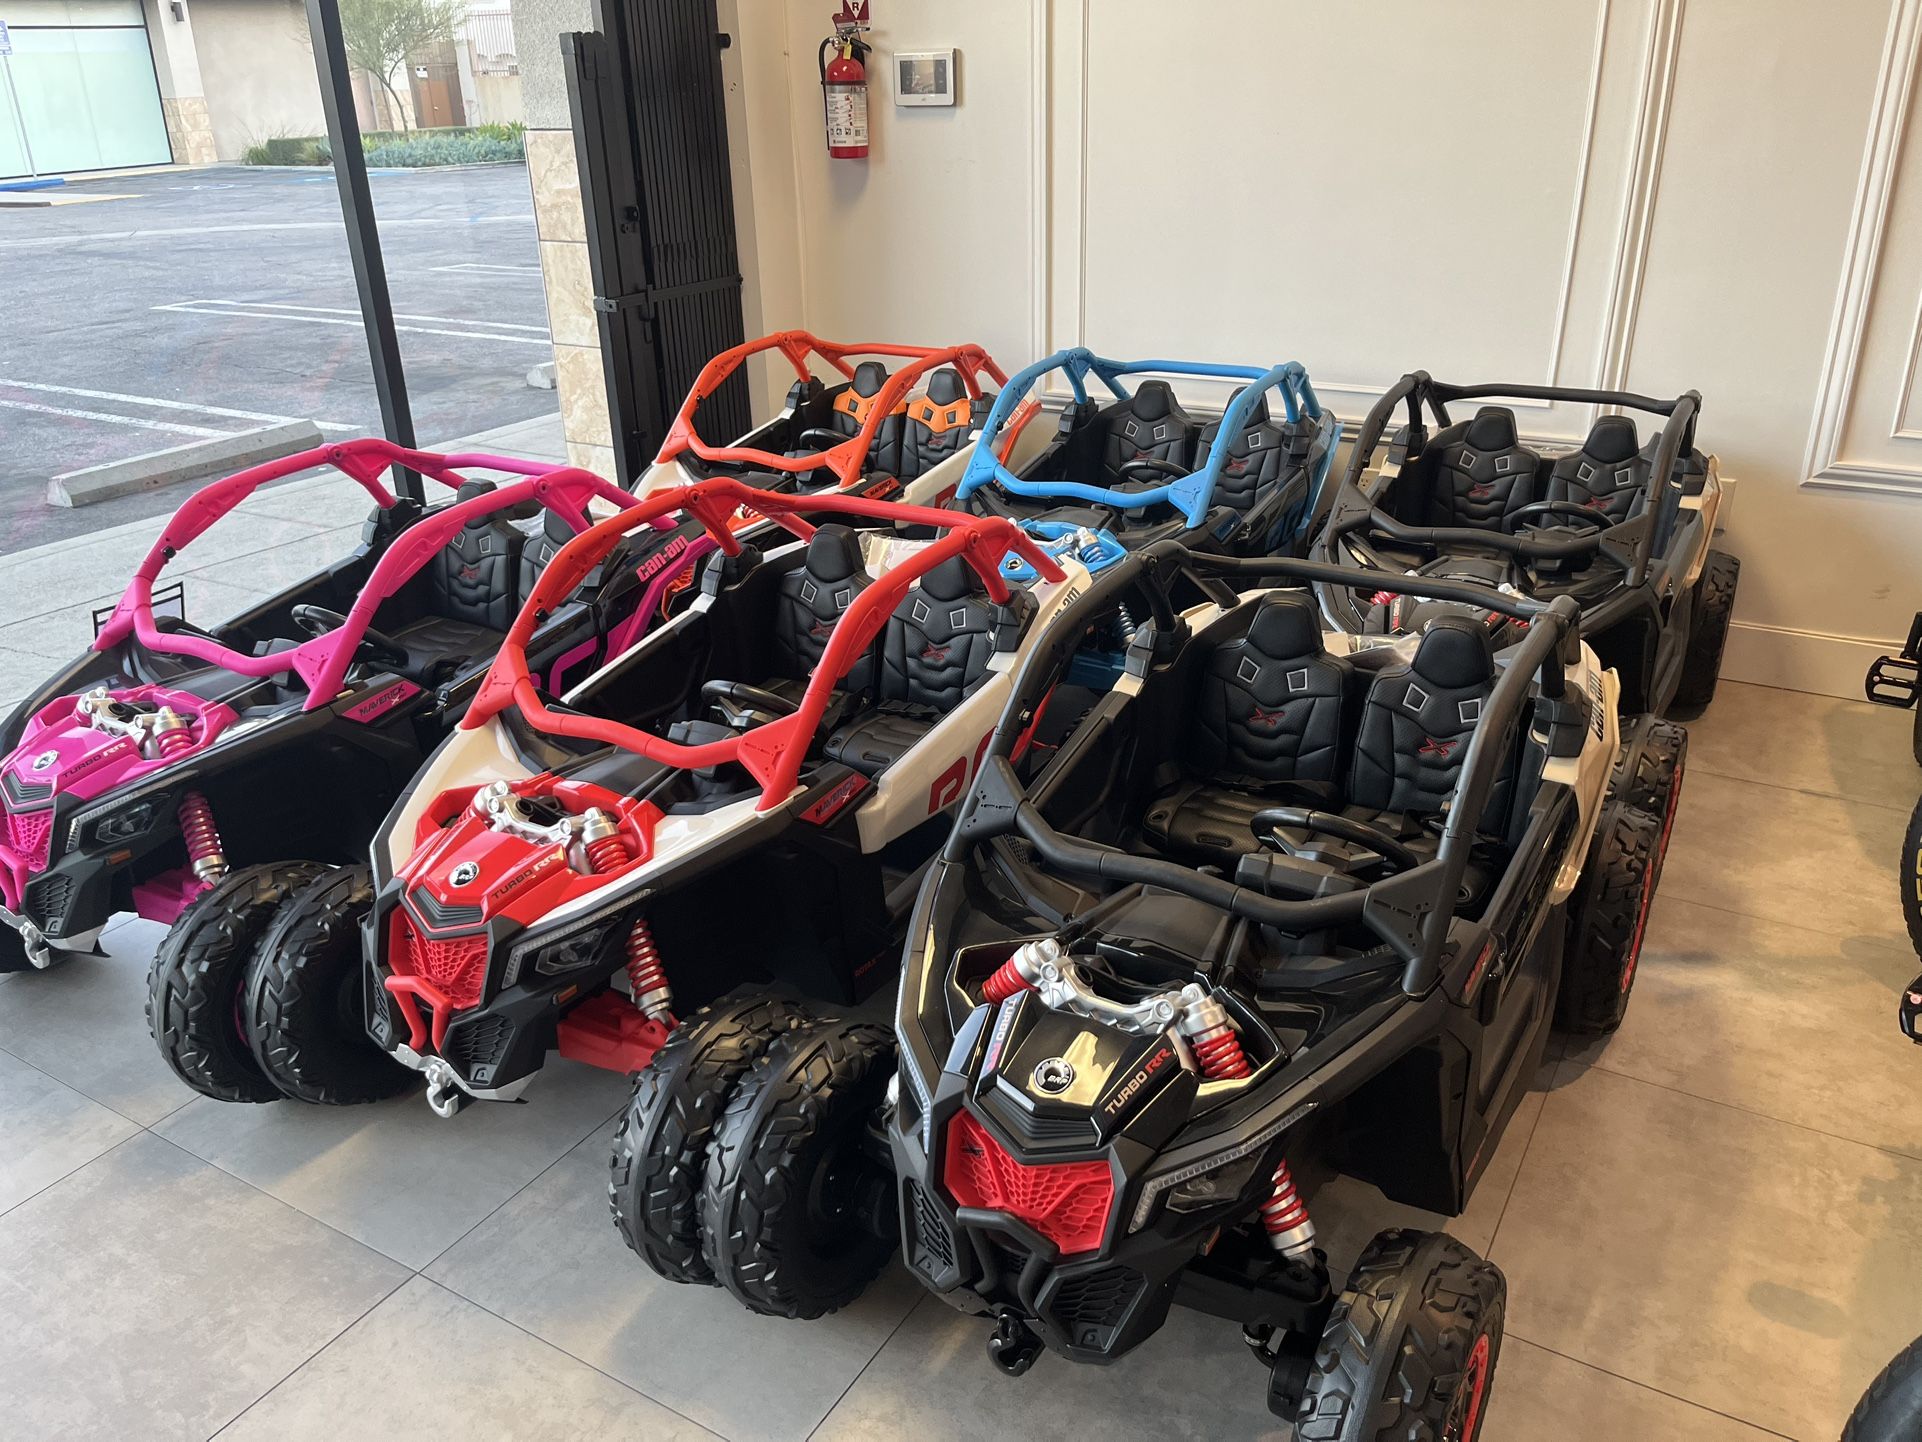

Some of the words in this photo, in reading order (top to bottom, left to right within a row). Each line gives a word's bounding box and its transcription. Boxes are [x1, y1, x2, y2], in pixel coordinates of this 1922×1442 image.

[636, 534, 689, 582] can-am
[63, 753, 102, 778] TURBO
[491, 868, 533, 899] TURBO
[996, 998, 1019, 1041] TURBO
[1104, 1072, 1148, 1115] TURBO
[1145, 1047, 1172, 1075] RR
